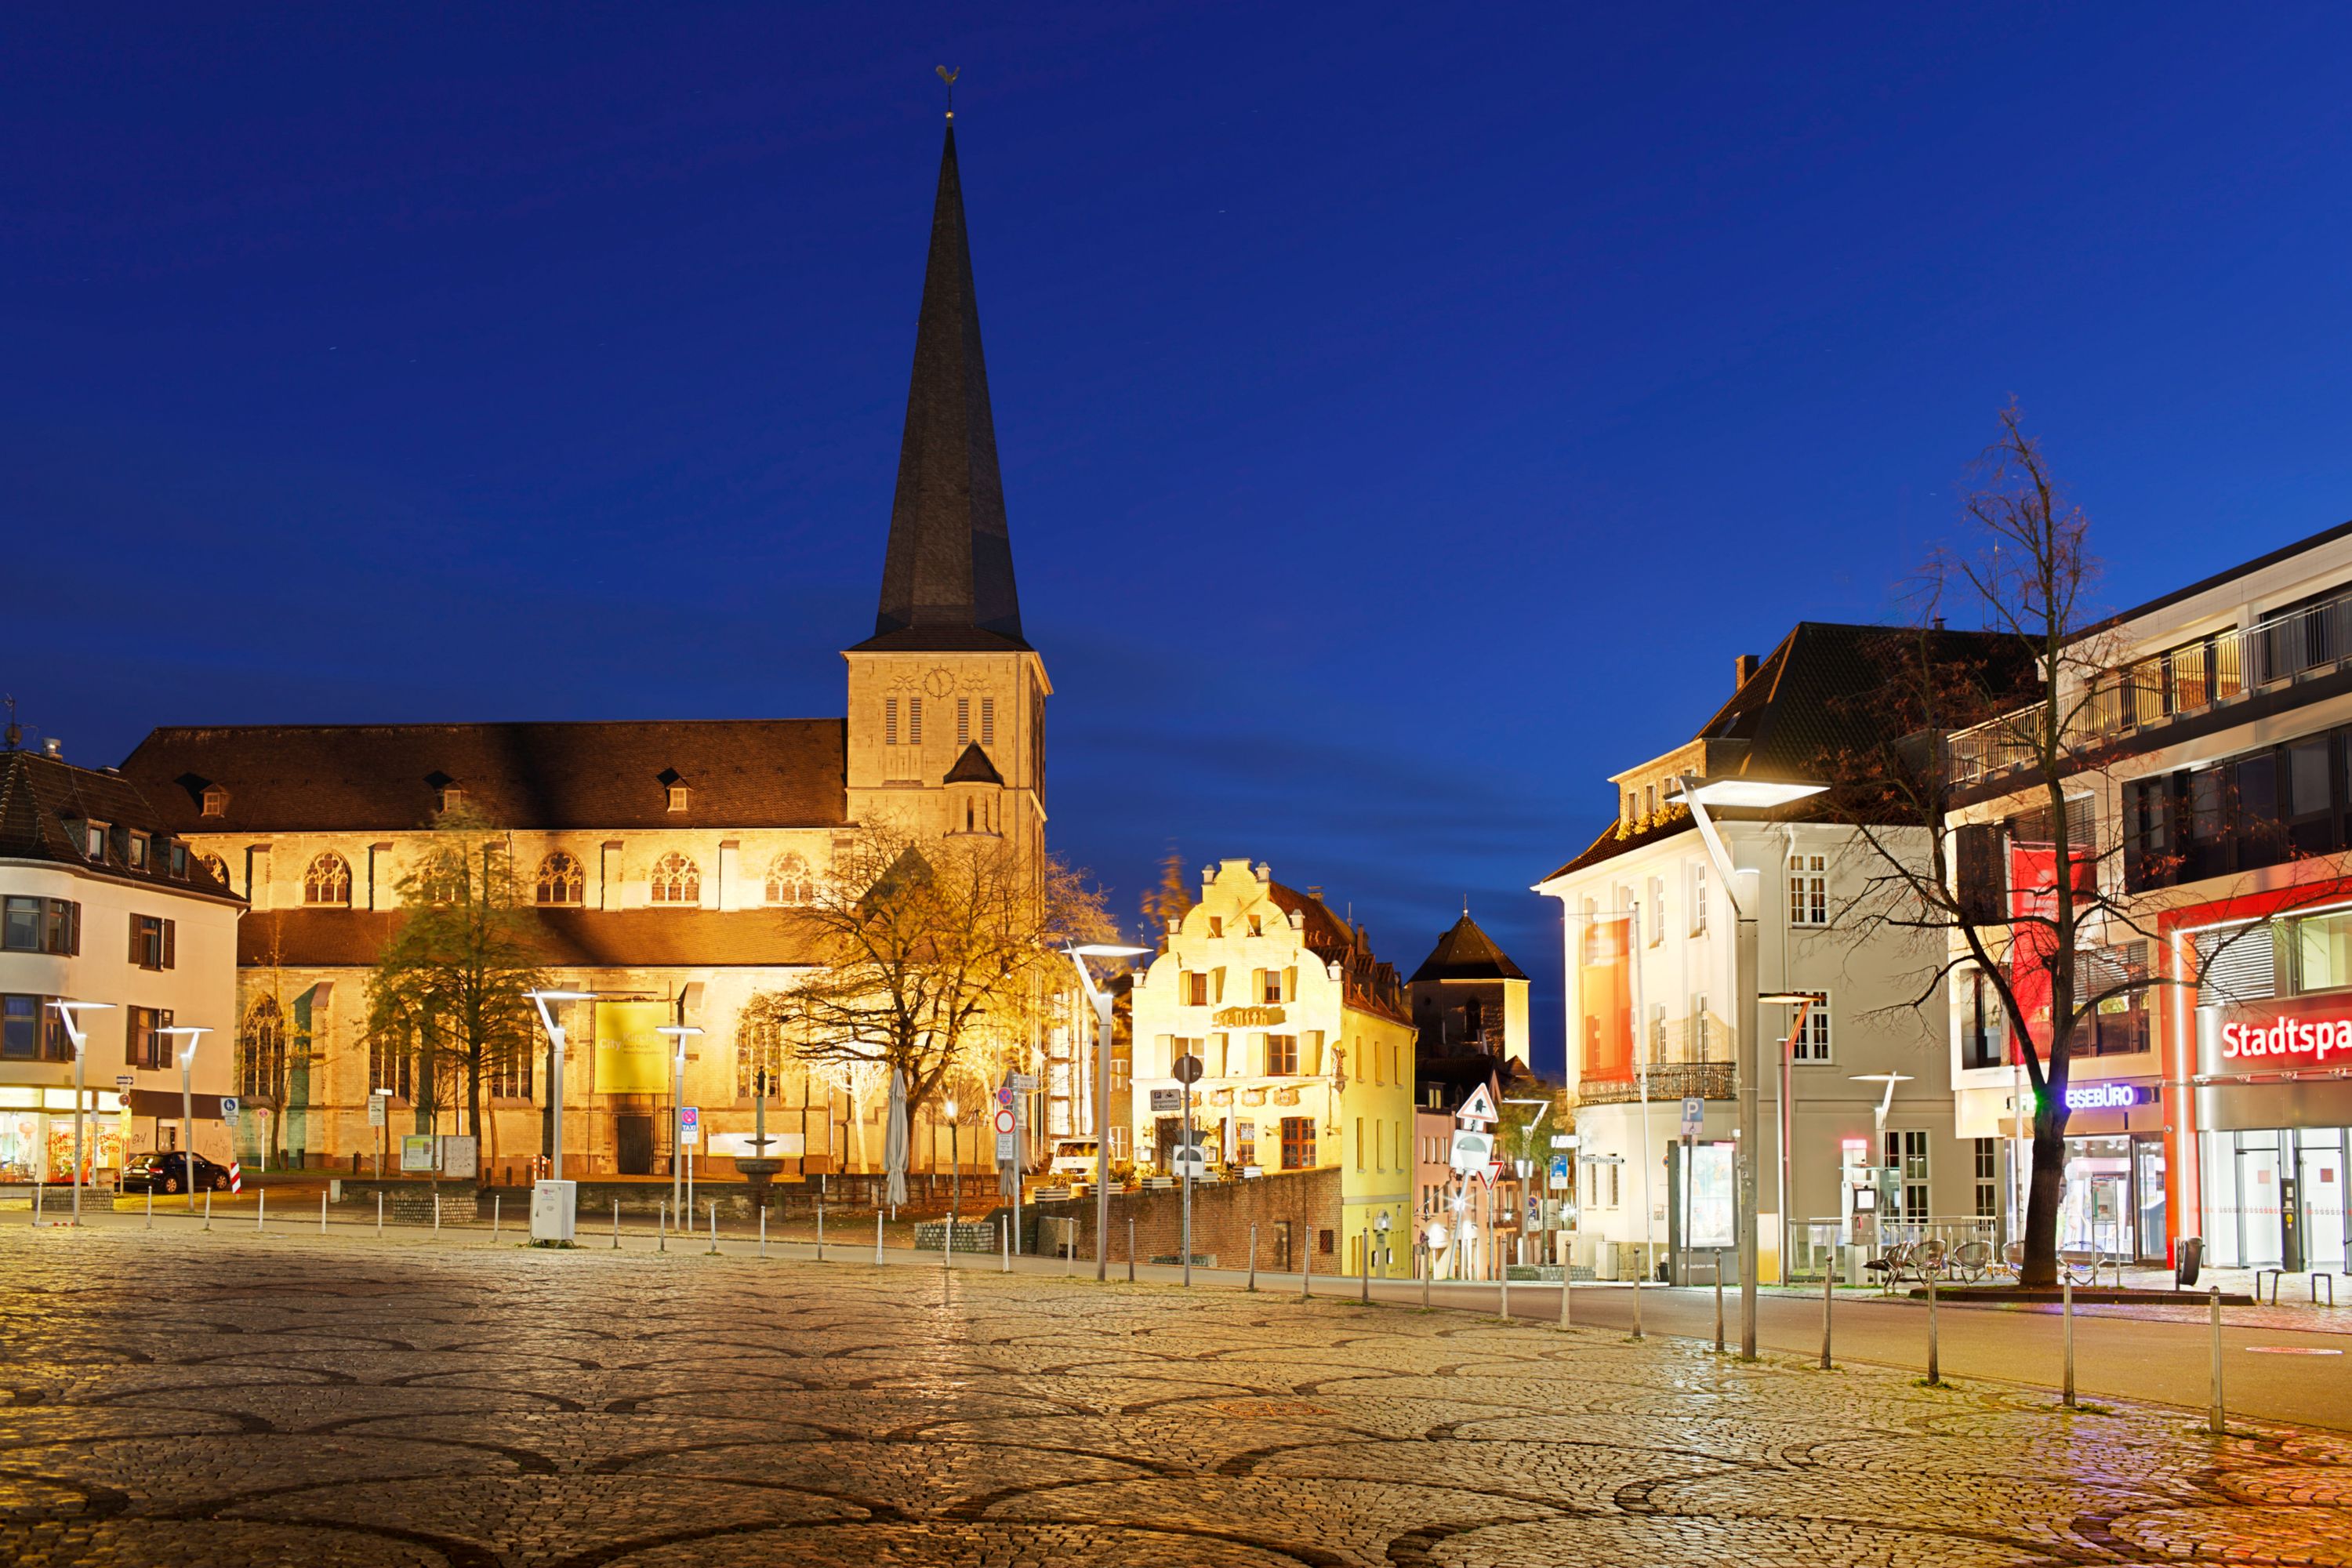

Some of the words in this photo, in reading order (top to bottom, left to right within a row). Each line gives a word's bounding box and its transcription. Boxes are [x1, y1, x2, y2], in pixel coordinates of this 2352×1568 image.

[599, 1038, 622, 1051] City
[622, 1031, 660, 1043] Kirche
[2223, 1016, 2352, 1060] Stadtspa
[2065, 1083, 2134, 1109] EISEBÜRO
[1686, 1102, 1698, 1120] P
[1597, 1156, 1621, 1164] Zeughaus
